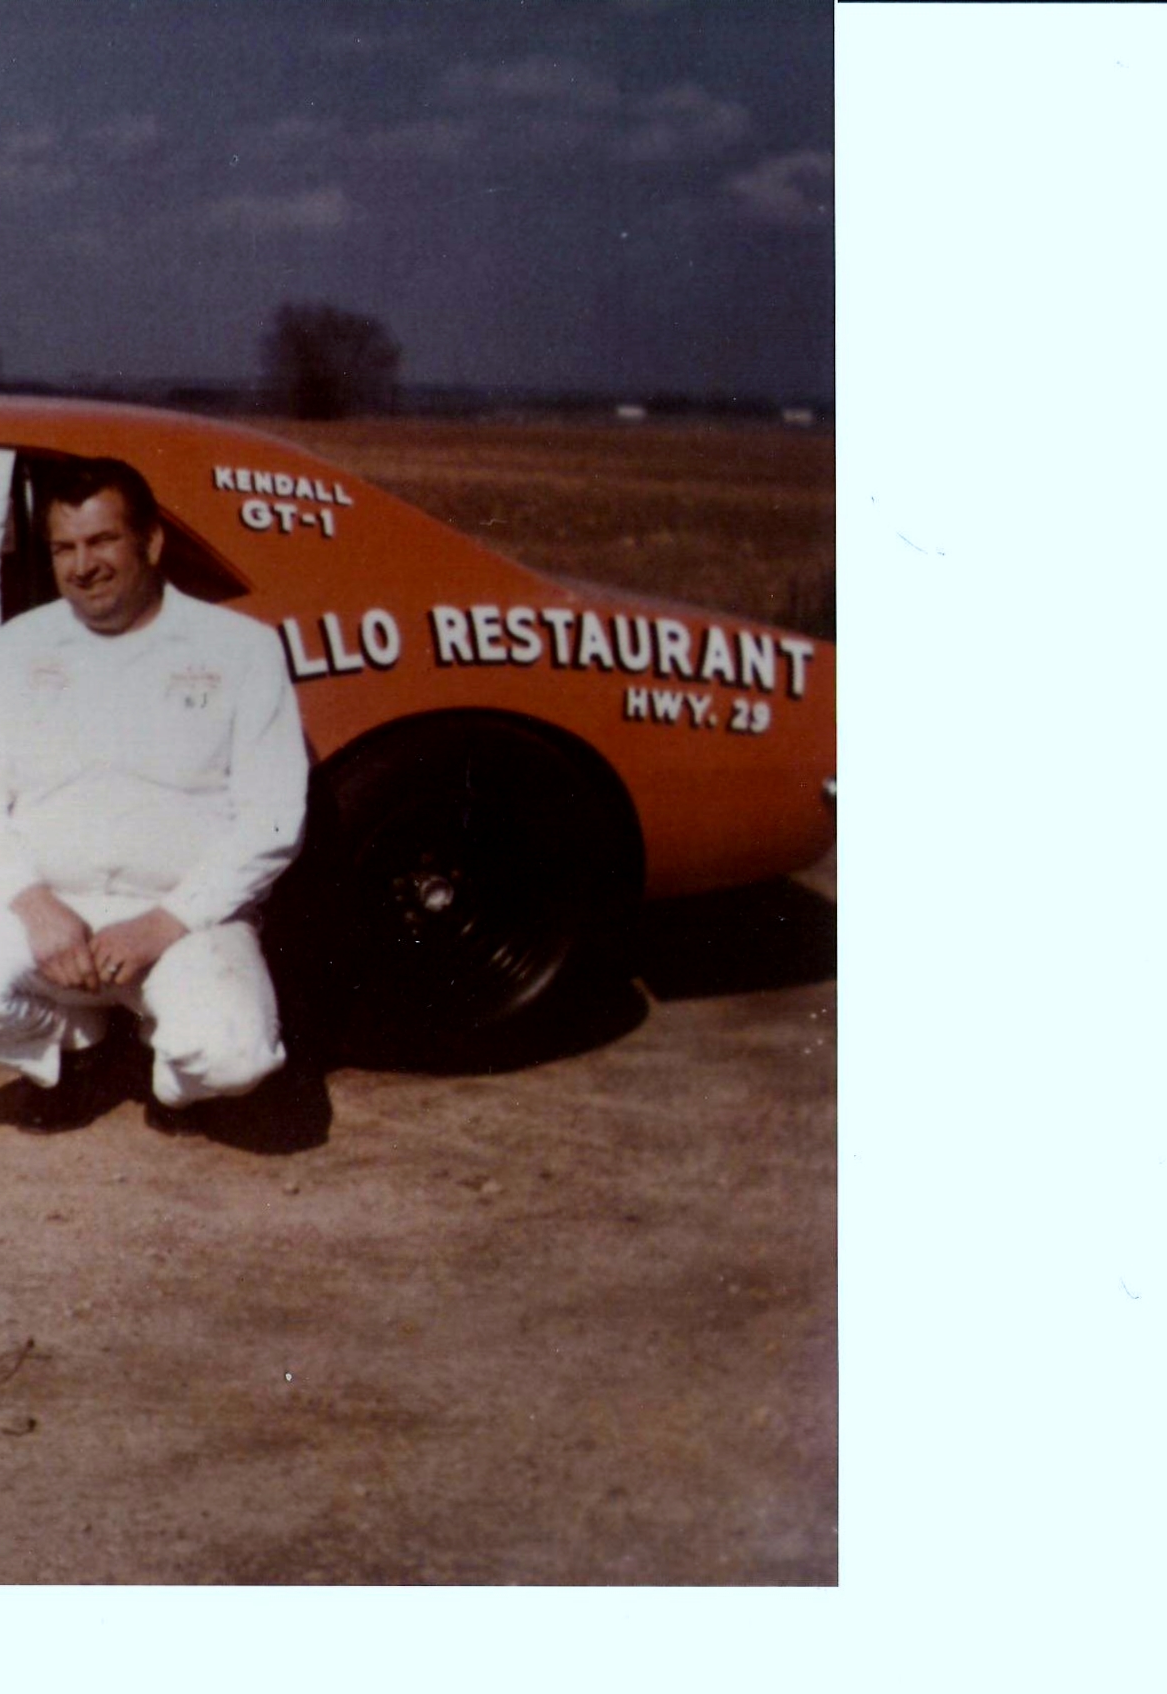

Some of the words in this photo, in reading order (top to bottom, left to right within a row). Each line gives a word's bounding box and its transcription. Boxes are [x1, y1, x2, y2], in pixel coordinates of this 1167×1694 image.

[214, 466, 353, 506] KENDALL
[240, 499, 336, 538] GT-1
[431, 606, 815, 699] RESTAURANT
[625, 686, 719, 730] HWY.
[730, 697, 772, 734] 29
